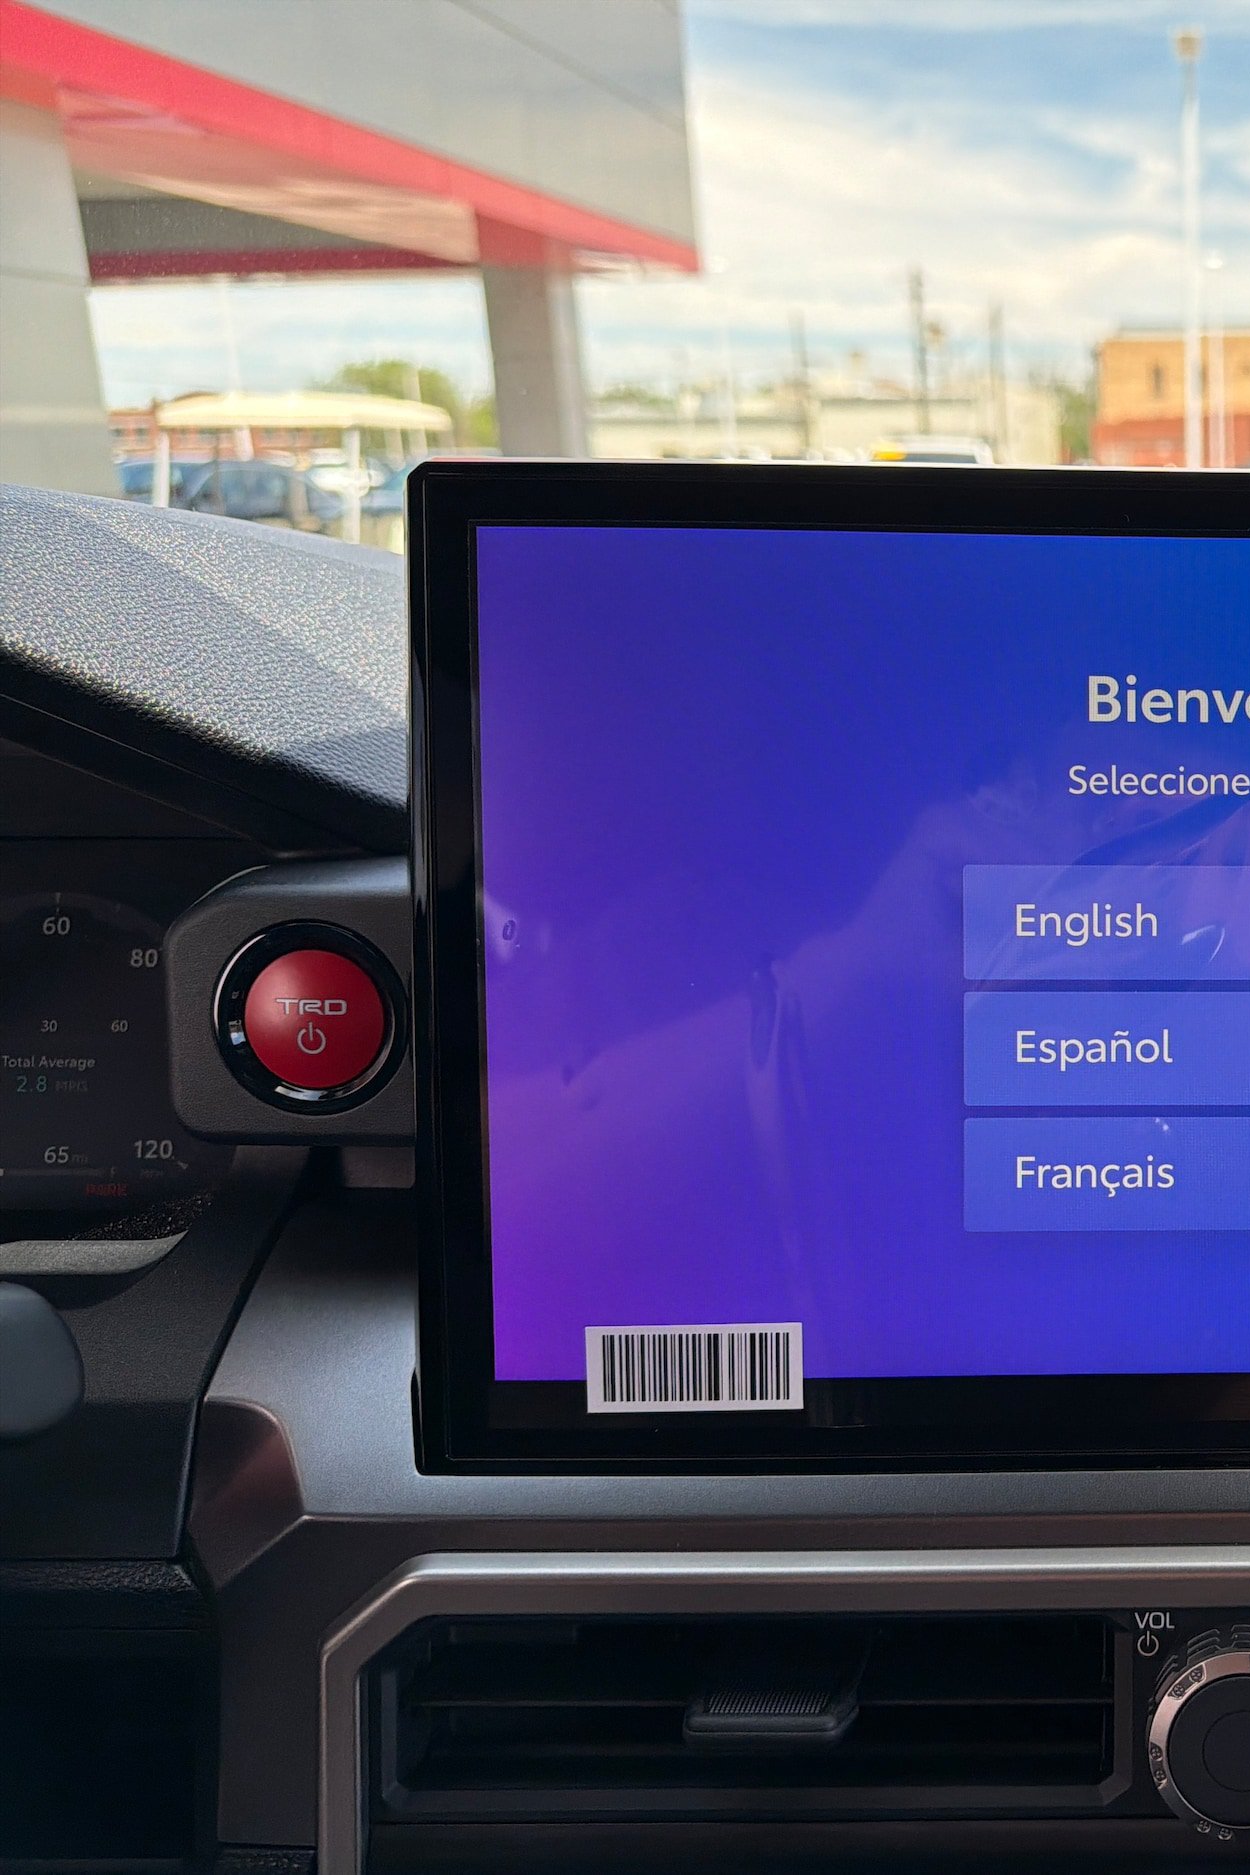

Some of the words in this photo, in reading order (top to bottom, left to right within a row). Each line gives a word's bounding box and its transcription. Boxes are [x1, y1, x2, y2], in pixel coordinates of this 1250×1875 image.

[1067, 764, 1250, 796] Seleccione
[42, 916, 71, 935] 60
[1015, 902, 1159, 947] English
[130, 948, 158, 968] 80
[275, 998, 348, 1016] TRD
[40, 1019, 58, 1033] 30
[110, 1019, 129, 1033] 60
[1015, 1028, 1174, 1072] Español
[1, 1055, 35, 1068] Total
[38, 1055, 96, 1072] Average
[16, 1075, 47, 1093] 2.8
[44, 1146, 69, 1164] 65
[133, 1139, 173, 1159] 120
[1015, 1153, 1176, 1198] Français
[1135, 1611, 1175, 1630] VOL
